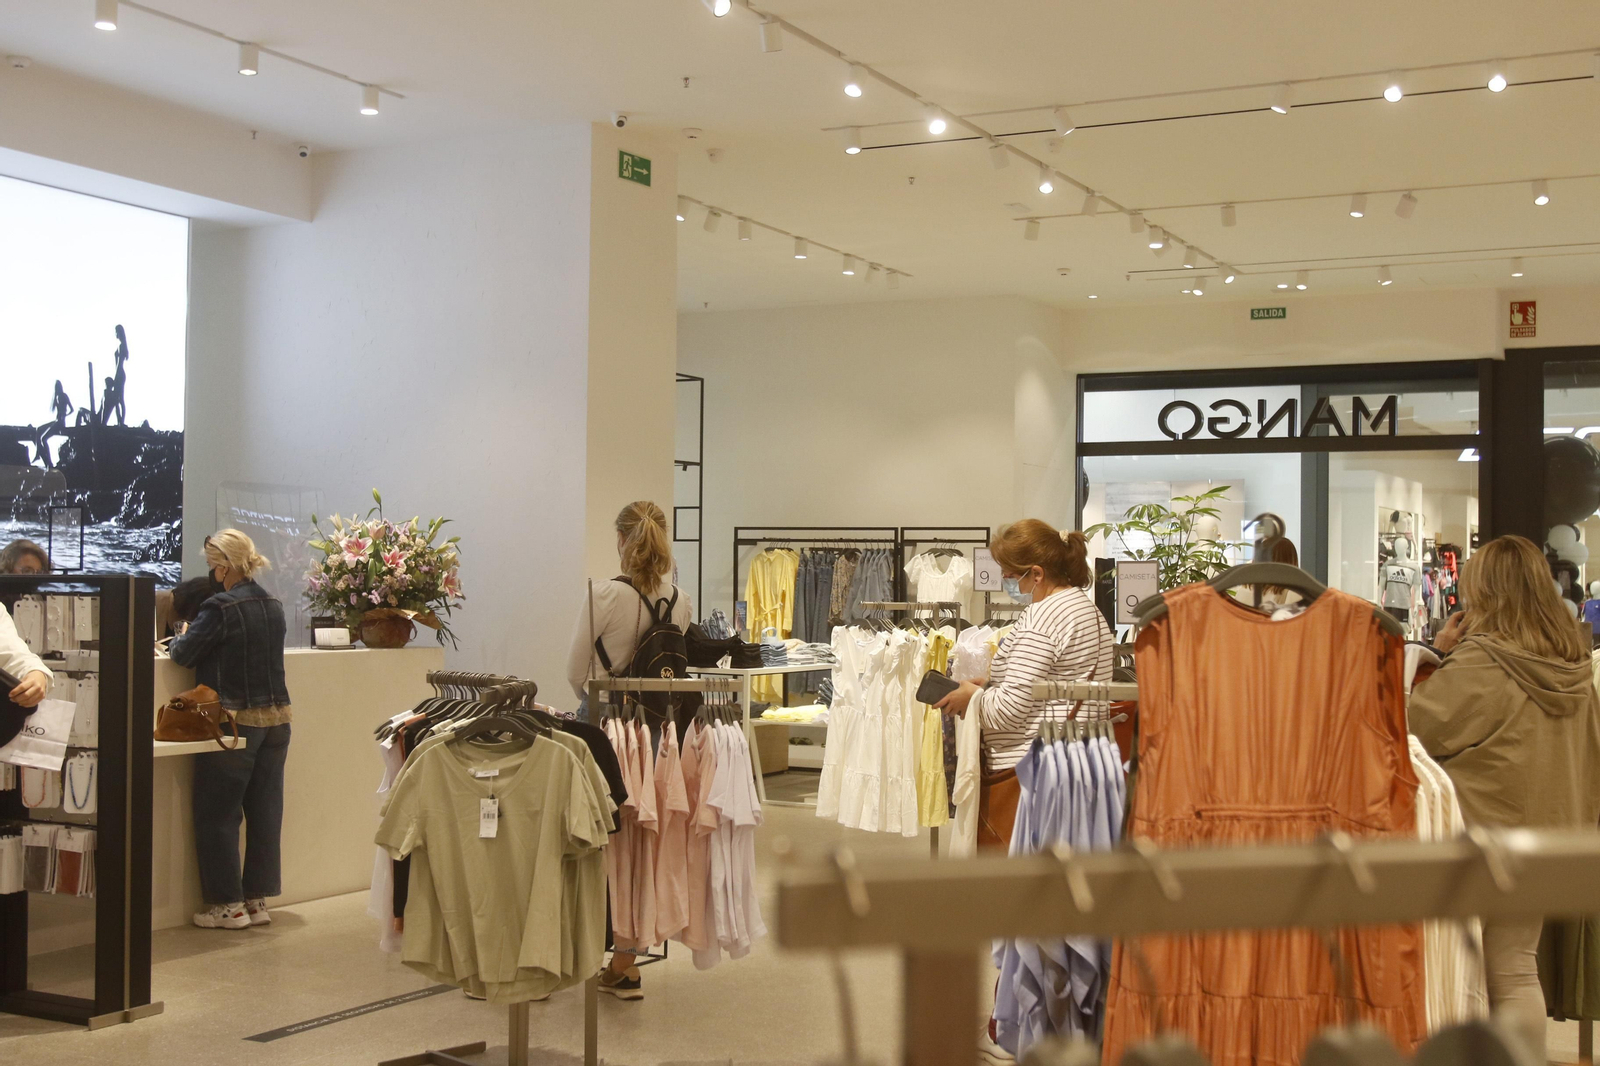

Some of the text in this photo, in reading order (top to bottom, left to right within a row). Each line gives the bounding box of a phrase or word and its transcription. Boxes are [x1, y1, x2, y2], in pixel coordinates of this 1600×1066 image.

[1252, 309, 1284, 318] SALIDA
[979, 570, 990, 585] 9
[1119, 573, 1156, 581] CAMISETA
